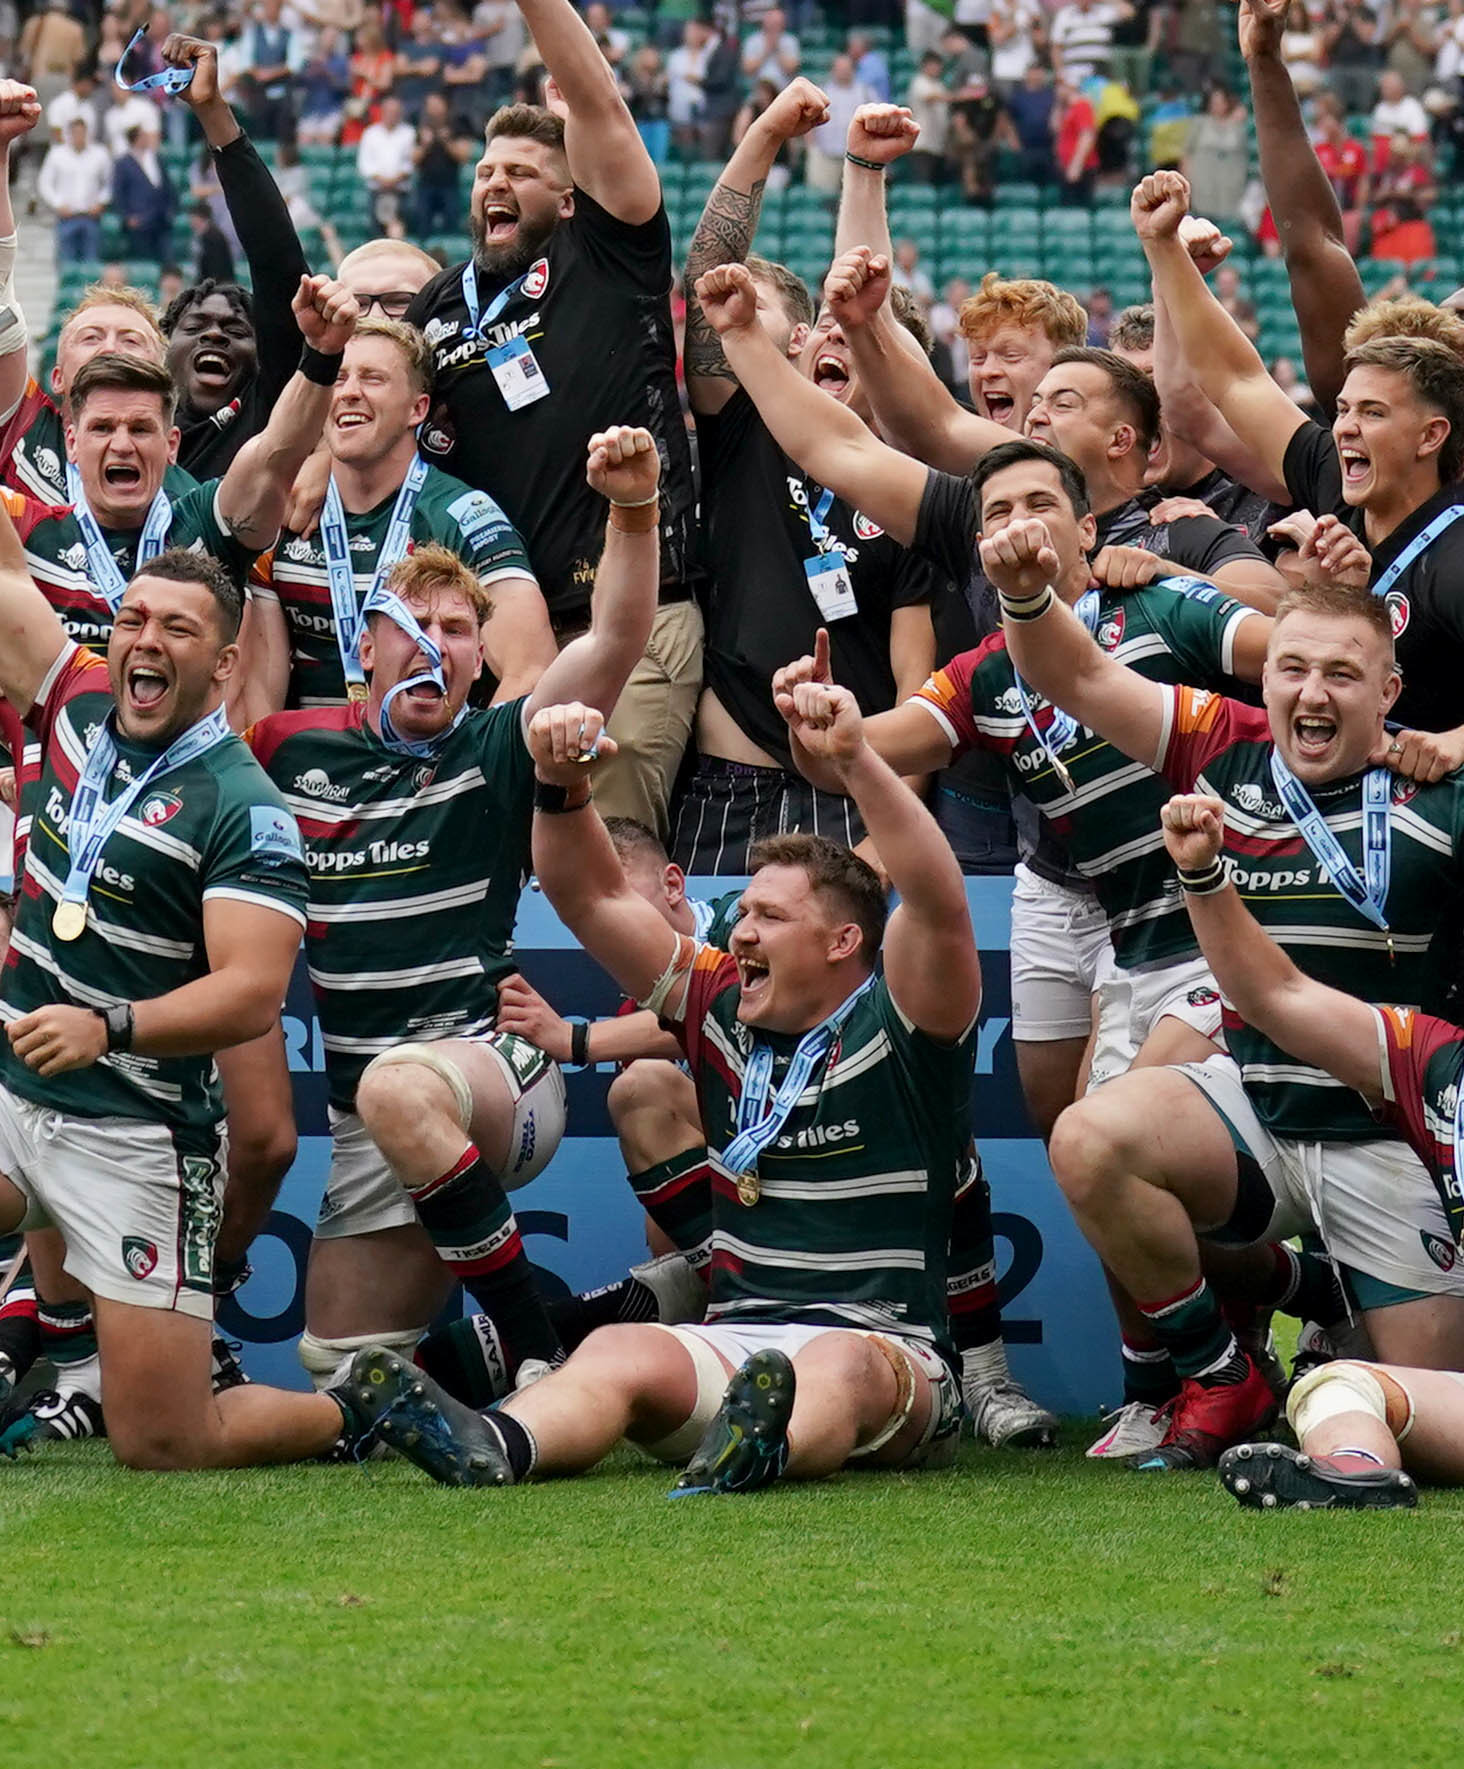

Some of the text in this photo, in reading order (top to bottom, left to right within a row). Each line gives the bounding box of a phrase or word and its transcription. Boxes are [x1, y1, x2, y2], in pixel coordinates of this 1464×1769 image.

[491, 312, 541, 345] Tiles
[55, 613, 114, 641] Topp
[303, 838, 430, 872] opps Tiles
[1219, 854, 1311, 889] Topps
[95, 857, 135, 893] les
[451, 1226, 511, 1259] TIGERS
[947, 1267, 991, 1291] GERS
[475, 1314, 502, 1383] SAMUR
